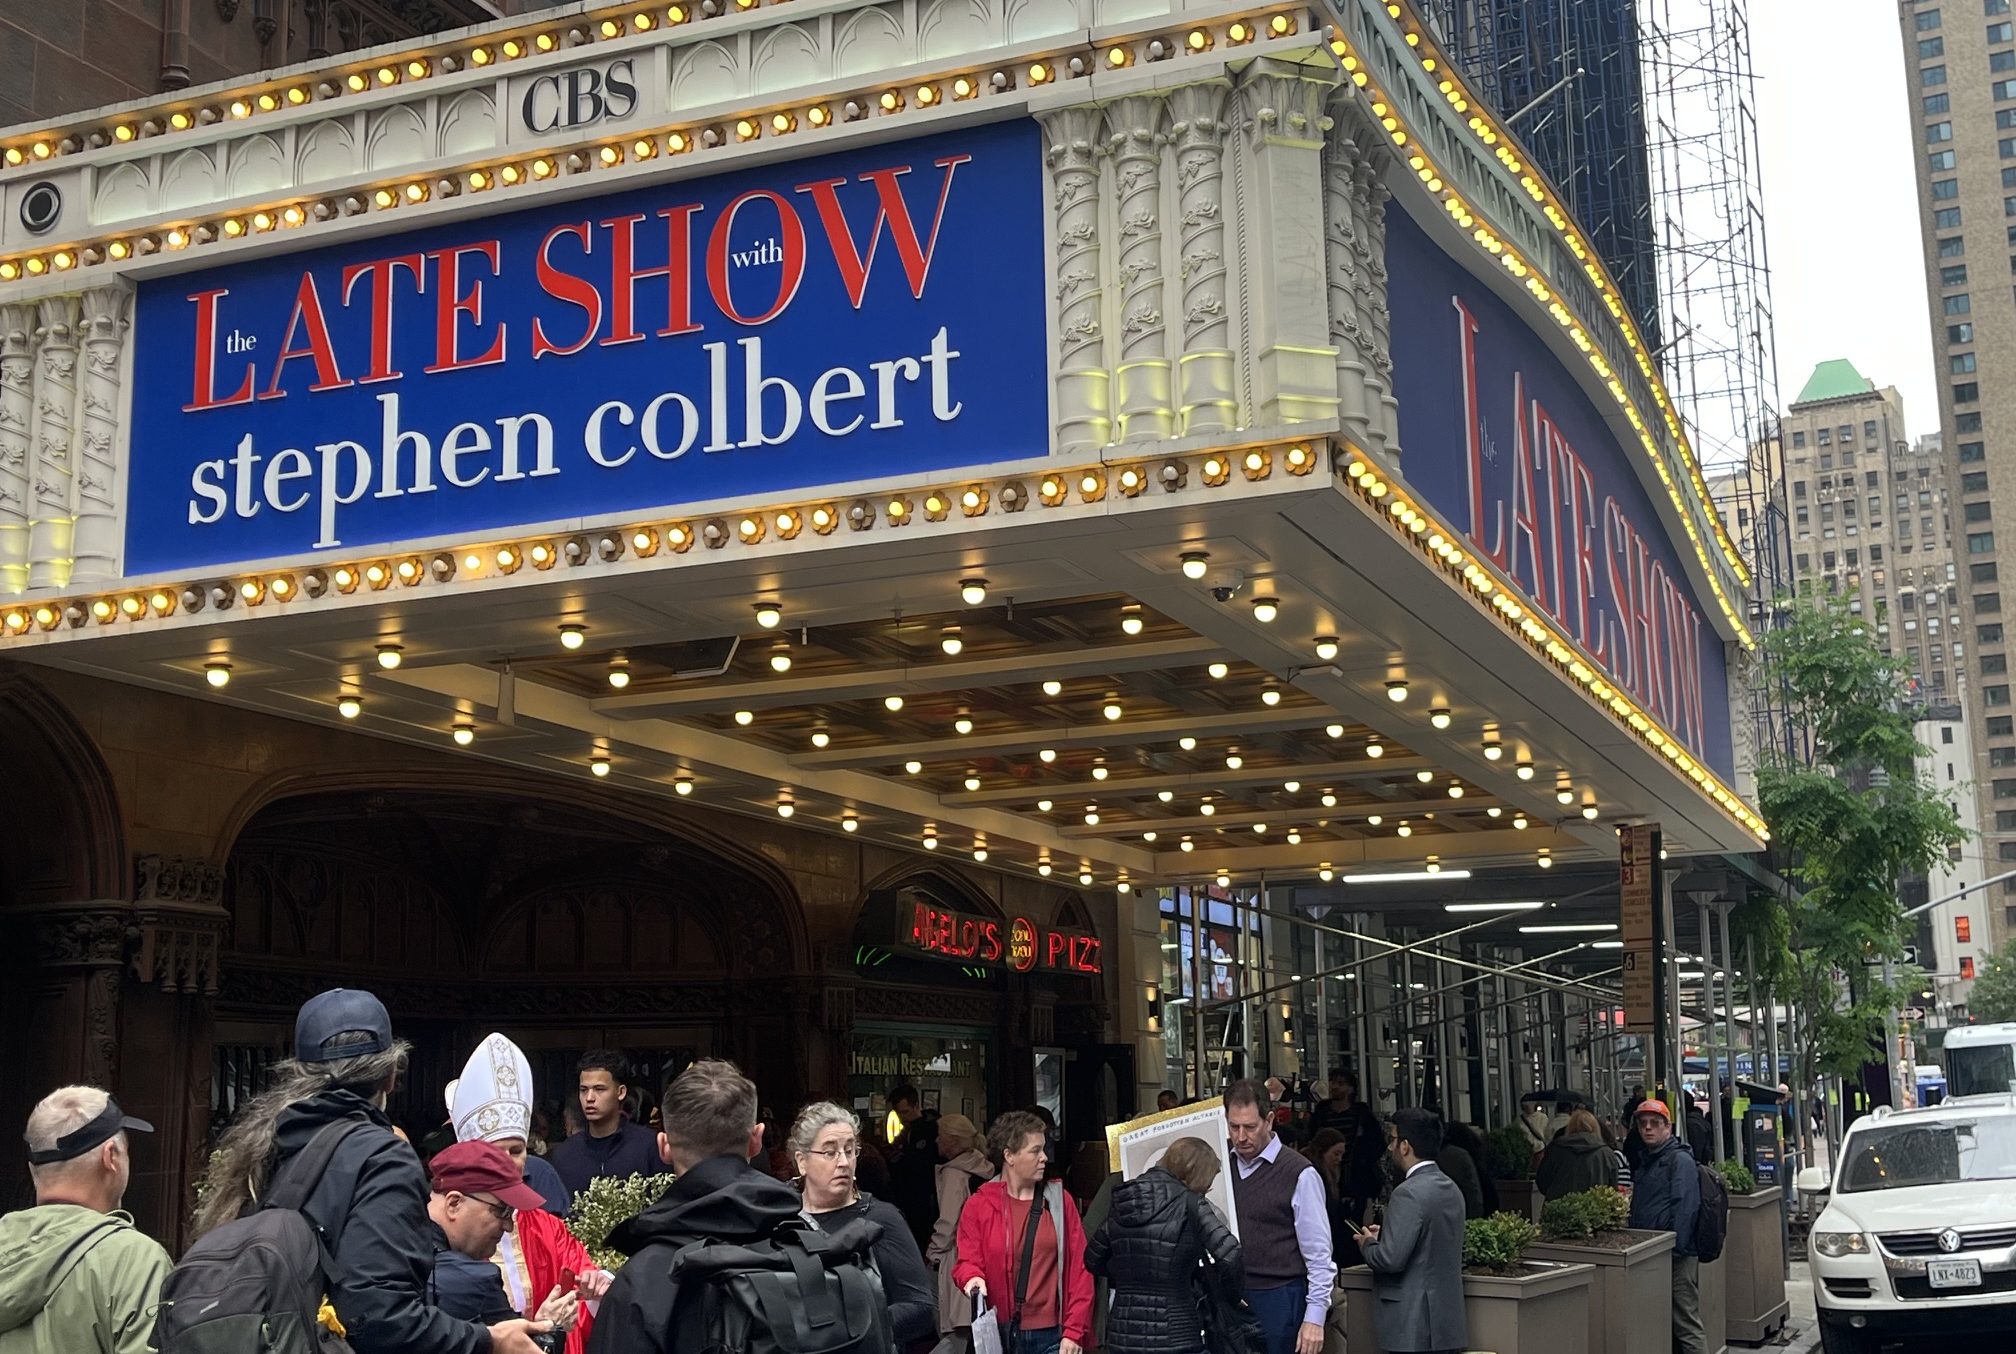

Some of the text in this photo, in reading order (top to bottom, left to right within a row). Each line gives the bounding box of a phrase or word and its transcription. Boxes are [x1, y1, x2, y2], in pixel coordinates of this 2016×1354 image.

[522, 59, 637, 135] CBS
[181, 154, 971, 413] LATE SHOW
[732, 240, 784, 269] with
[226, 330, 256, 355] the
[188, 326, 963, 549] stephen colbert
[1452, 295, 1705, 764] LATE SHOW
[852, 1051, 898, 1075] ITALIAN
